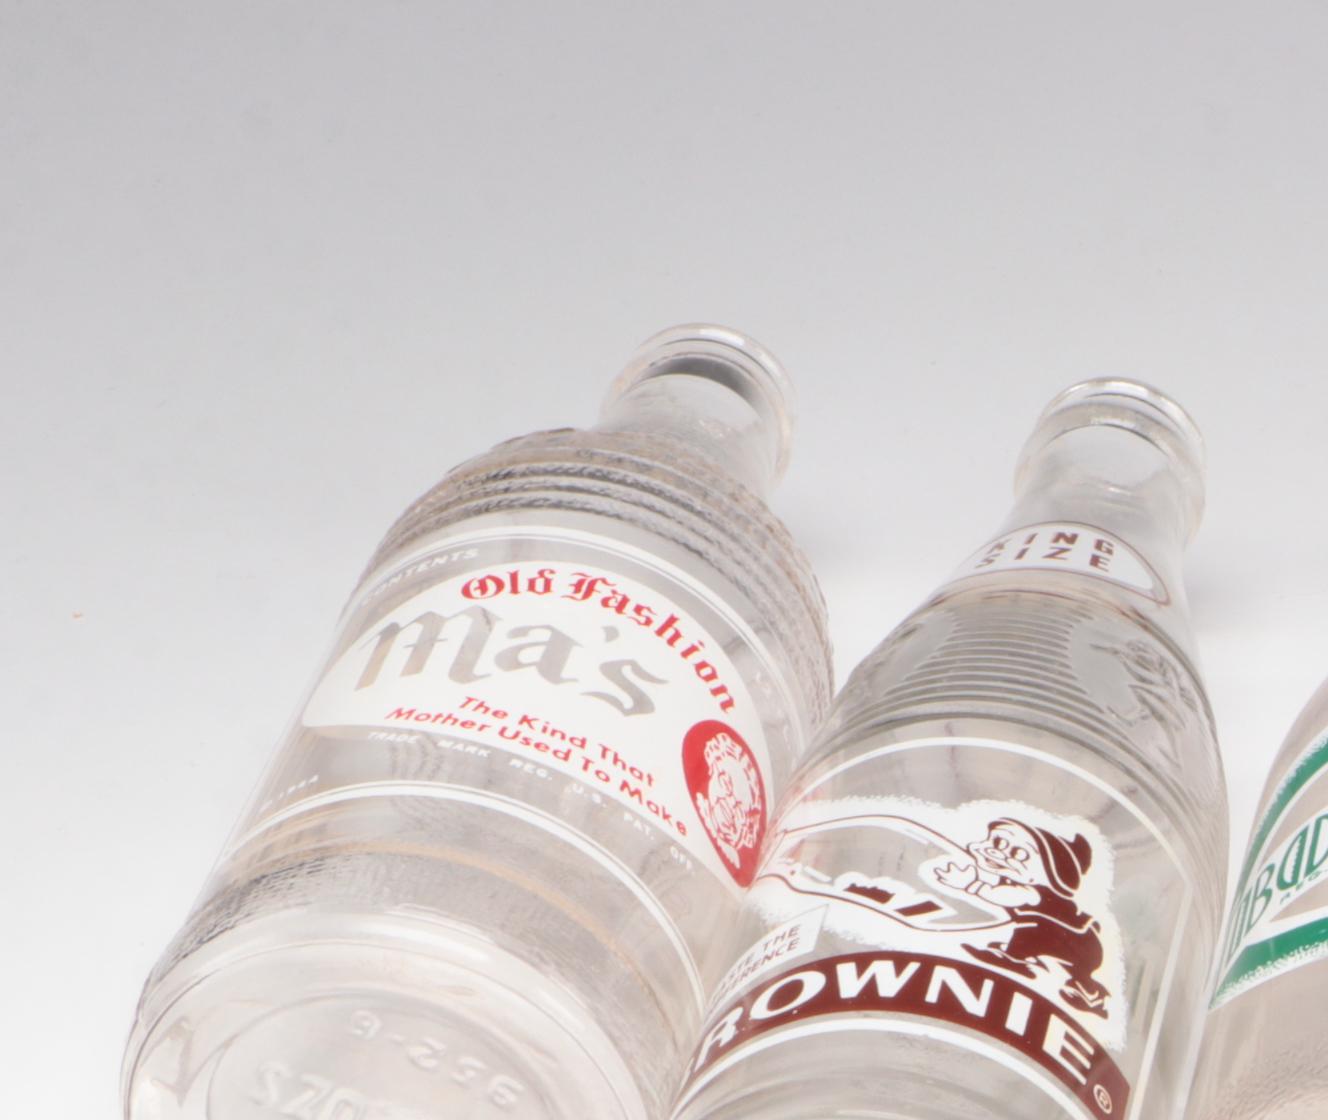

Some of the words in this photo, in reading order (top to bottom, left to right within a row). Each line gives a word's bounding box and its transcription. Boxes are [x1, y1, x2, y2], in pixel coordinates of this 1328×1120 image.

[974, 547, 1112, 572] SIZE
[354, 605, 670, 716] Ma's
[461, 569, 556, 600] Old
[569, 572, 737, 713] Fashion
[384, 707, 490, 731] Mother
[498, 726, 571, 761] Used
[581, 756, 611, 783] To
[619, 780, 688, 836] Make
[459, 697, 507, 719] The
[518, 714, 587, 749] Kind
[598, 743, 654, 786] That
[763, 924, 801, 952] THE
[695, 958, 1096, 1085] ROWNIE
